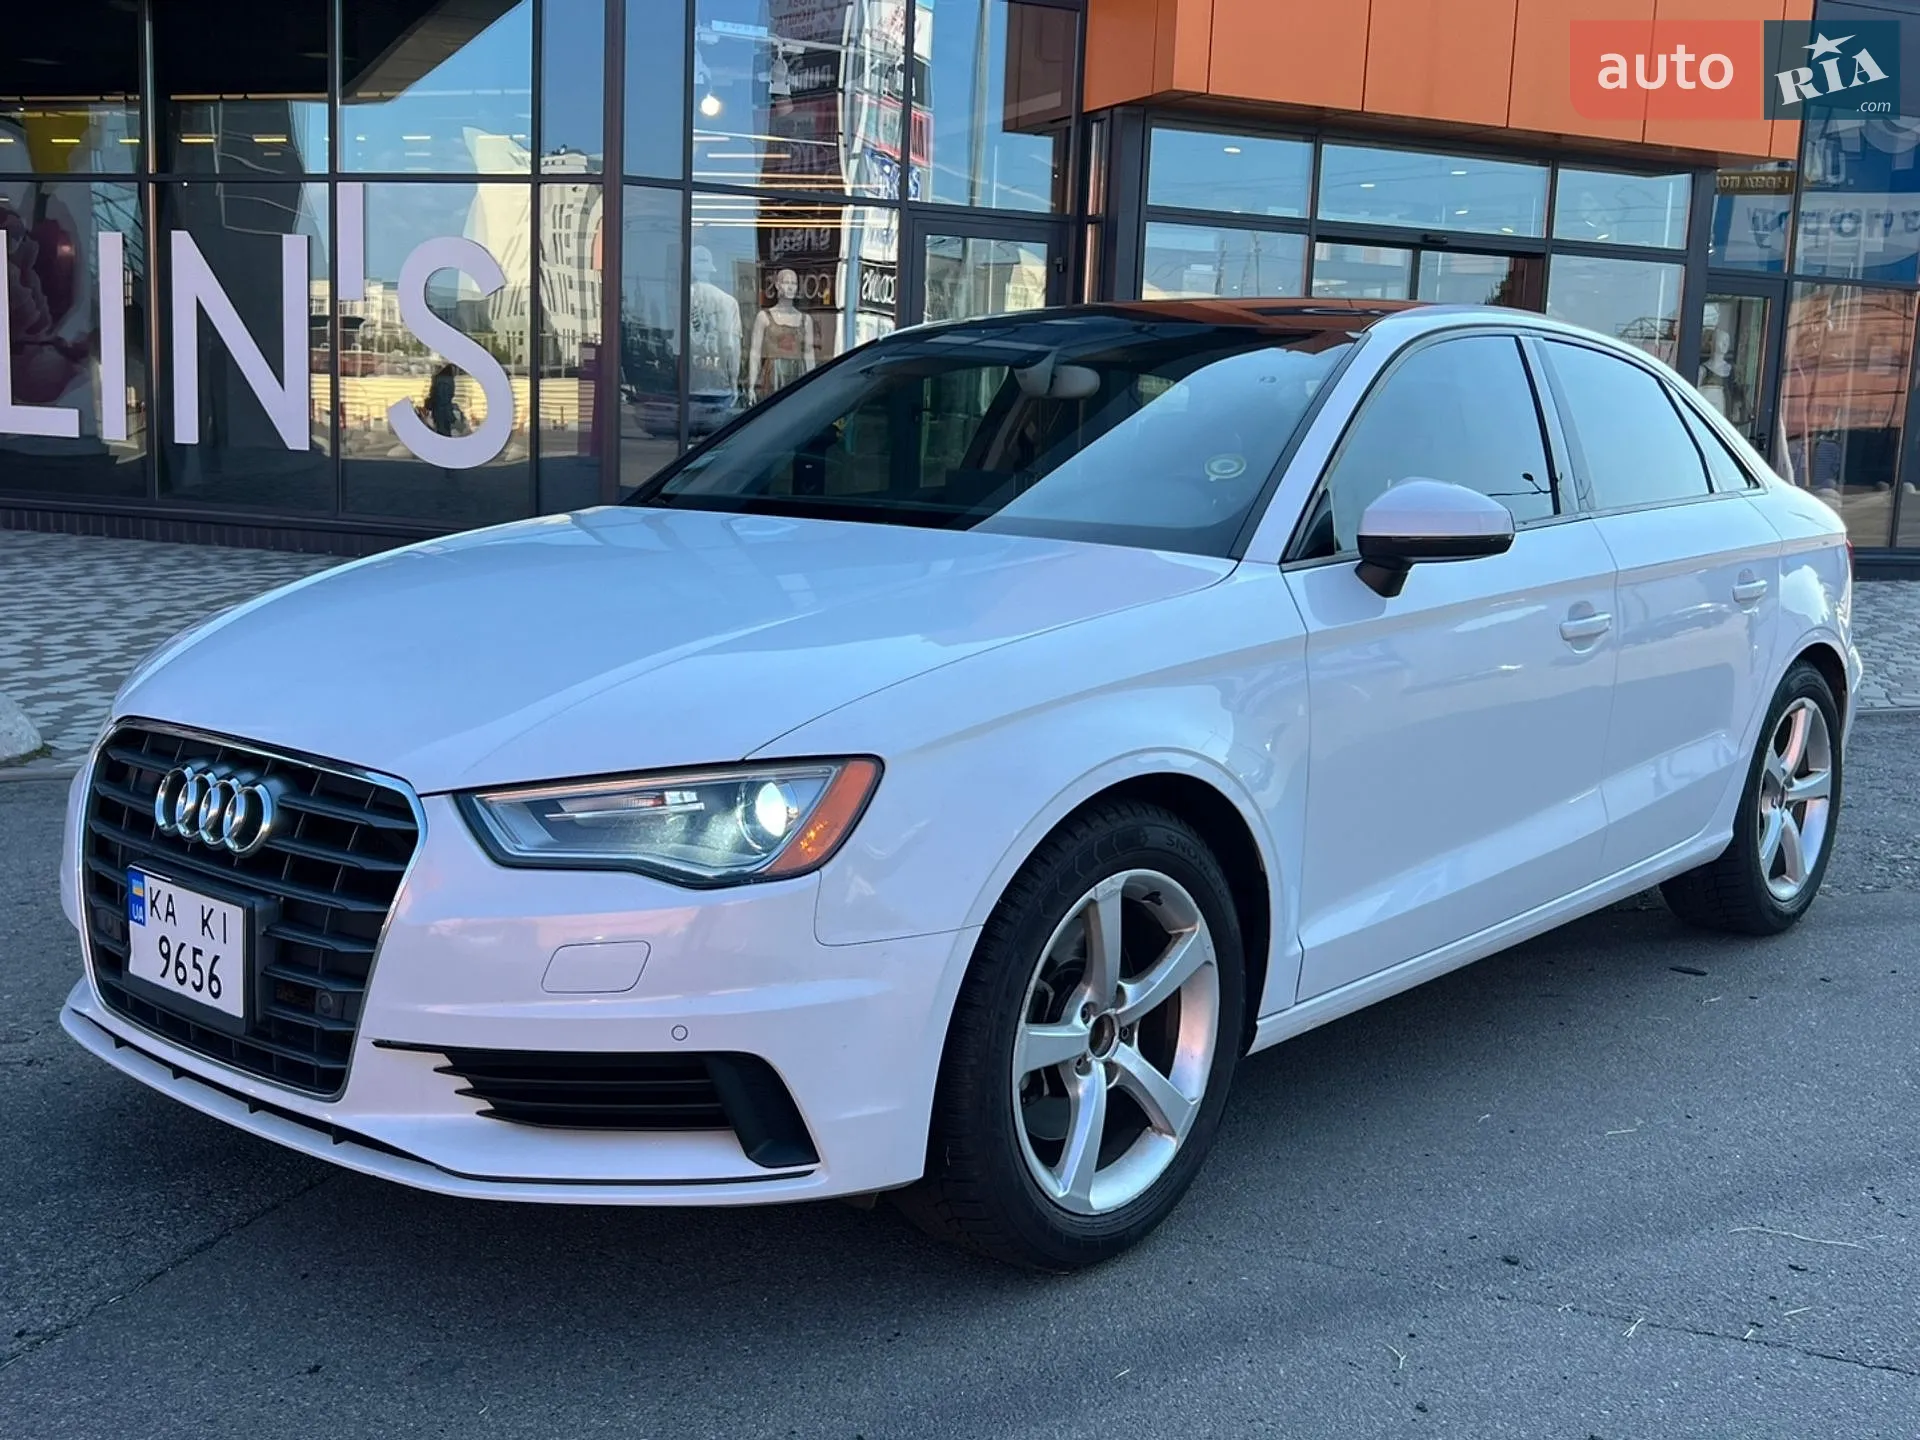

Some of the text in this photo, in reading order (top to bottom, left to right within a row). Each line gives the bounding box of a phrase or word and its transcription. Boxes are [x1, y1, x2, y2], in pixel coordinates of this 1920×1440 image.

[0, 183, 514, 469] LIN'S
[132, 902, 145, 924] UA
[150, 886, 228, 944] KA KI
[158, 935, 222, 1000] 9656
